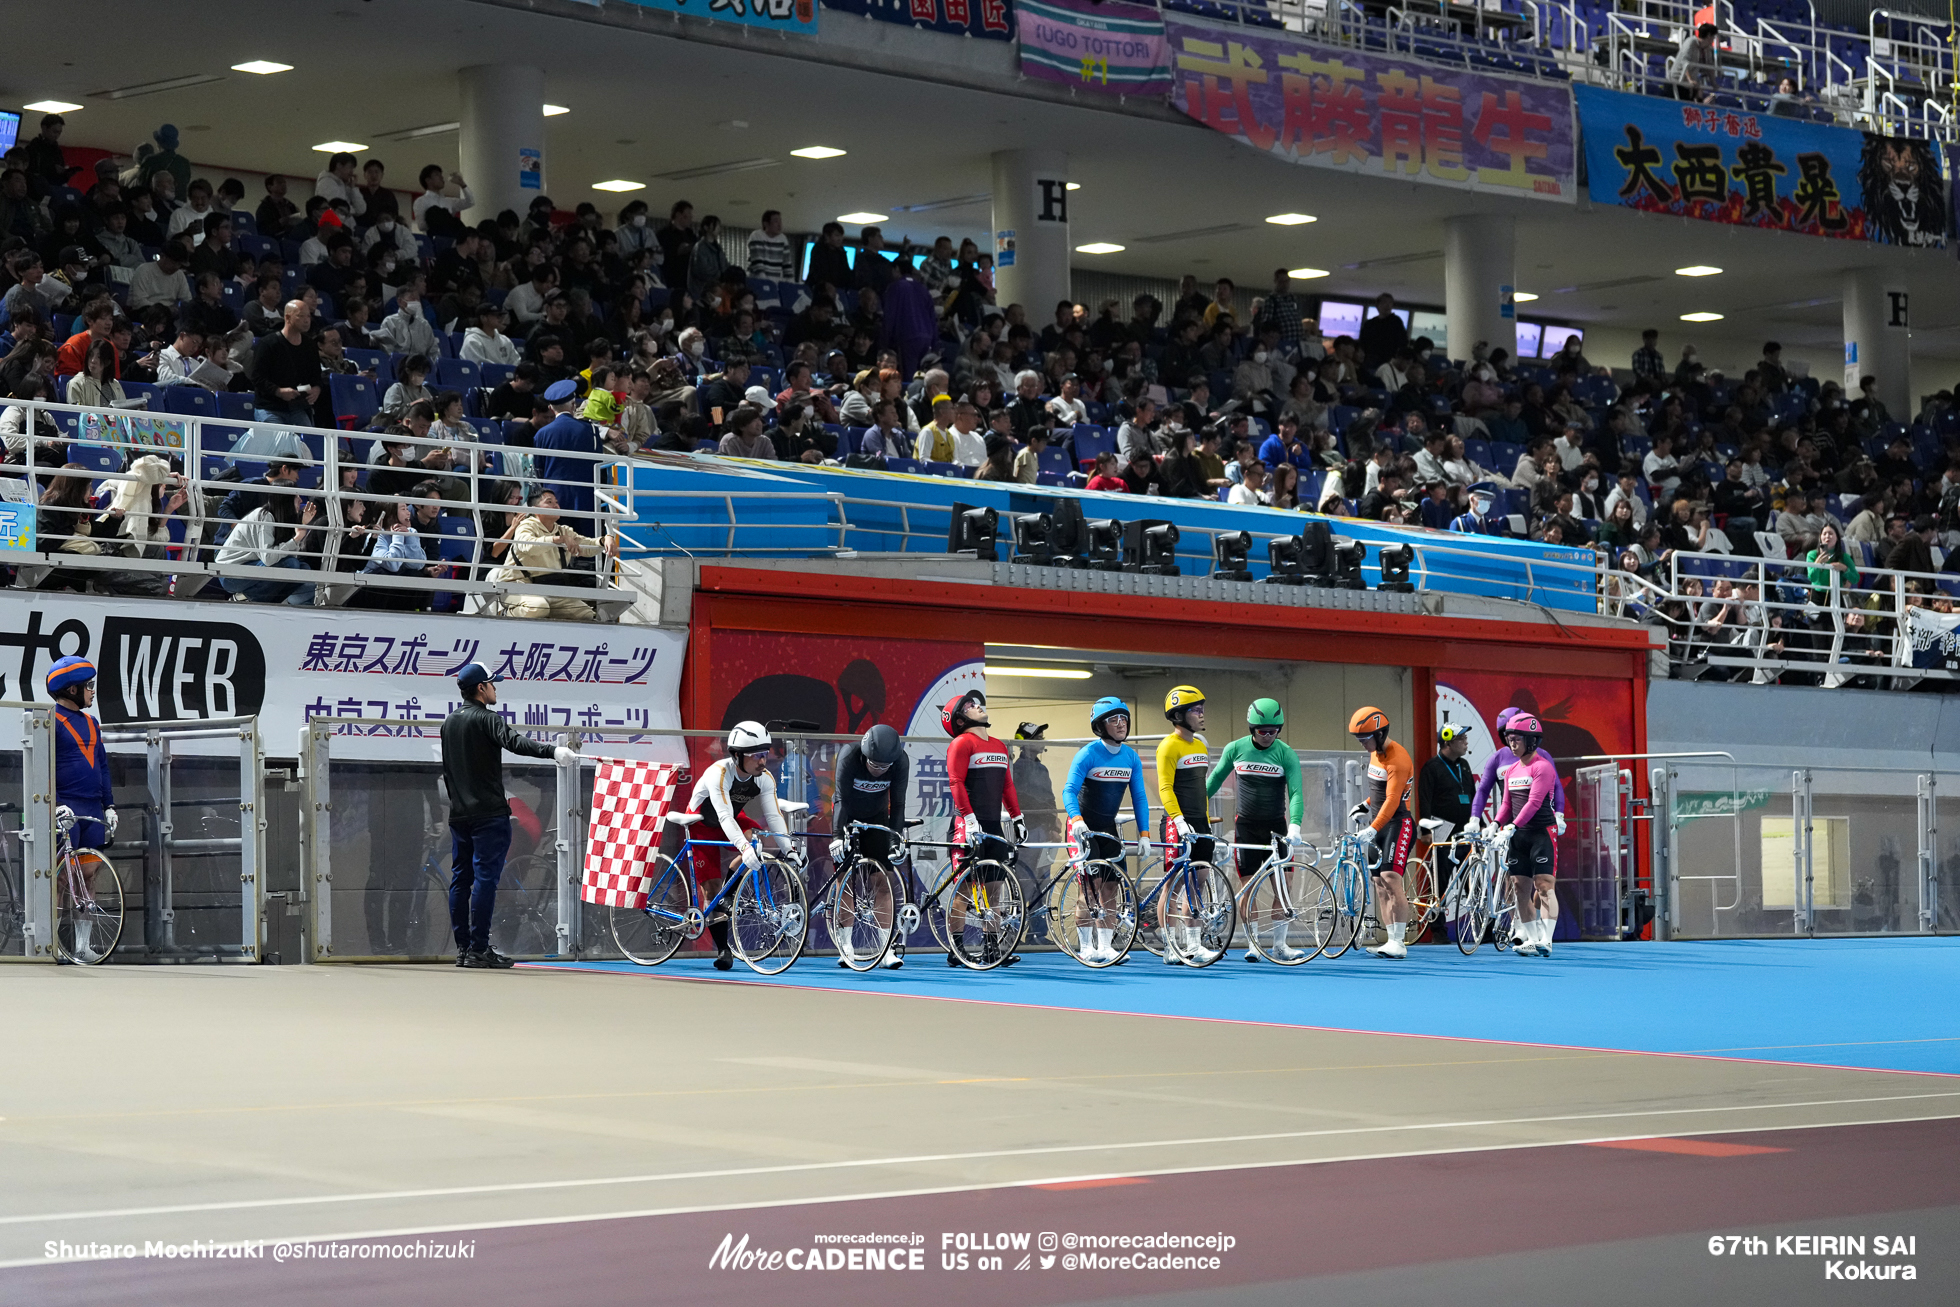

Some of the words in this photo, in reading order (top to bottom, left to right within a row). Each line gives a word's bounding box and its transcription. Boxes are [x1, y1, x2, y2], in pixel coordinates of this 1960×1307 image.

[1075, 17, 1108, 30] OKAYAMA
[1081, 35, 1149, 58] TOTTORI
[1080, 53, 1107, 85] #1
[1176, 37, 1556, 189] 武藤龍生
[1614, 123, 1848, 232] 大西貴晃
[1037, 179, 1068, 223] H
[1887, 291, 1908, 327] H
[302, 631, 480, 677] 東京スポーツ
[499, 641, 658, 684] 大阪スポーツ
[119, 634, 238, 719] WEB
[1171, 692, 1180, 706] 5
[305, 696, 465, 739] 中京スポー
[1373, 715, 1381, 729] 7
[1529, 719, 1537, 731] 8
[731, 730, 739, 745] 1
[986, 755, 1008, 763] KEIRIN
[1245, 764, 1279, 773] KEIRIN
[1103, 769, 1131, 777] KEIRIN
[859, 782, 889, 790] KEIRIN
